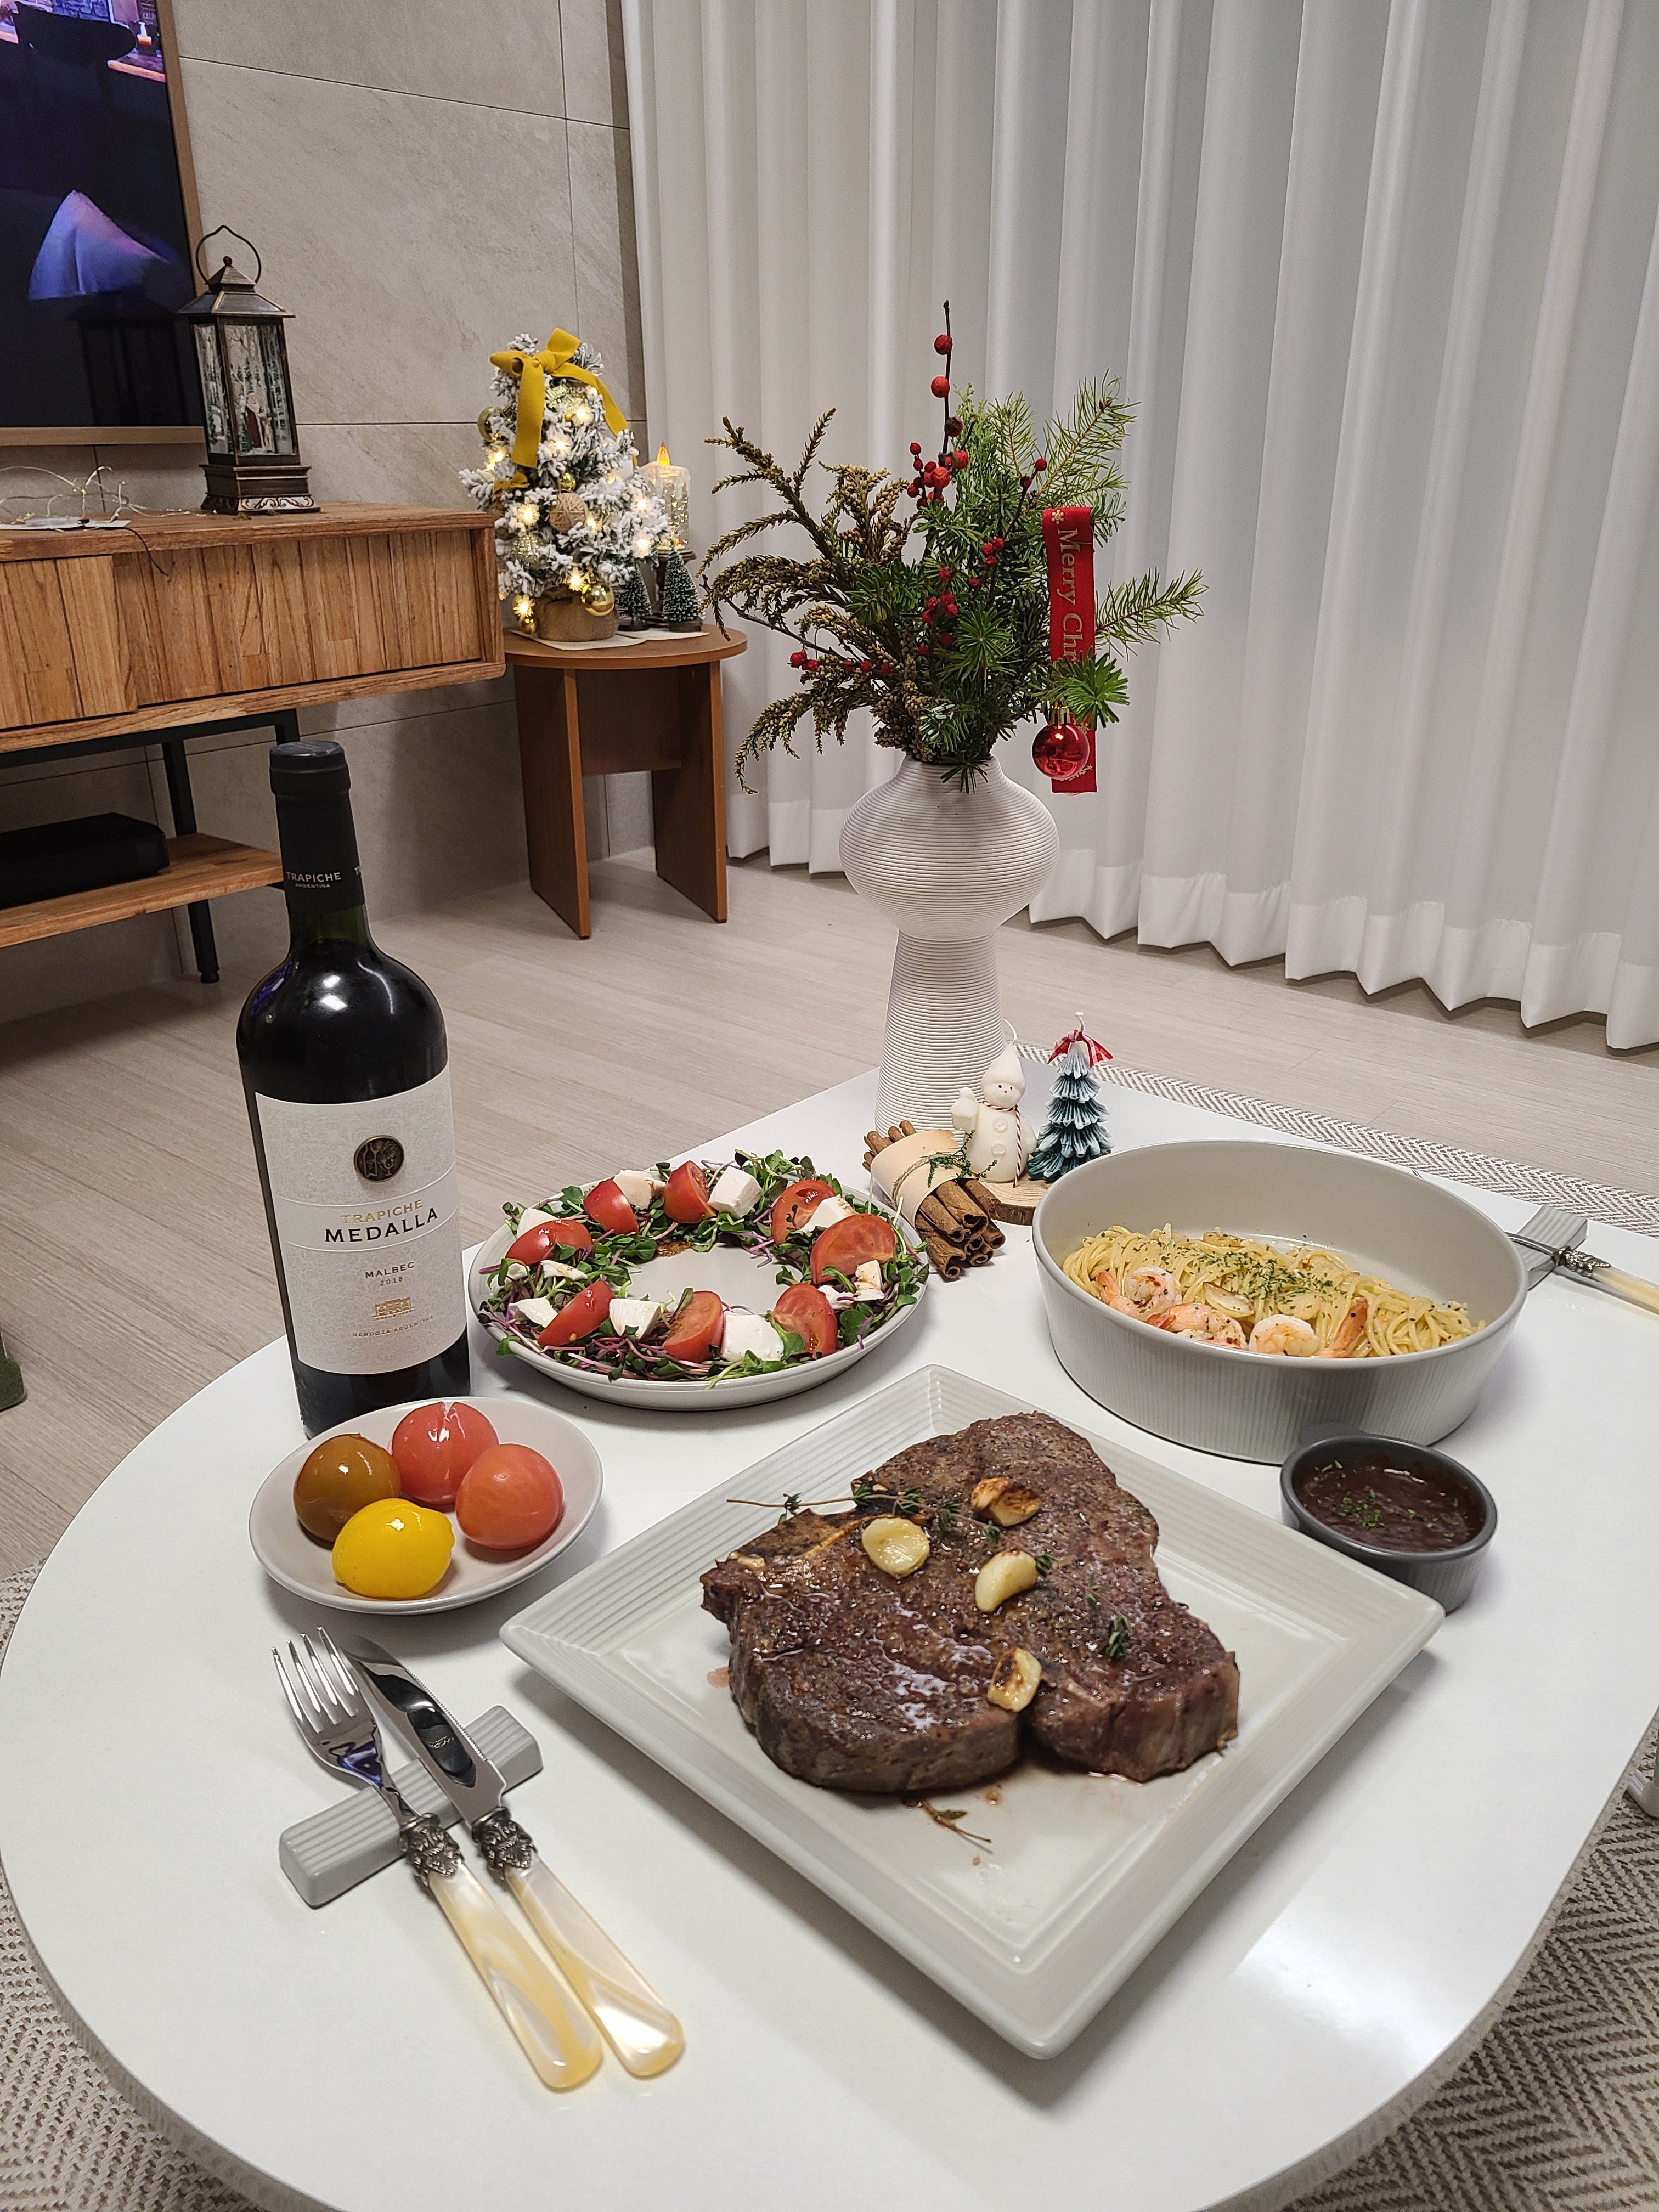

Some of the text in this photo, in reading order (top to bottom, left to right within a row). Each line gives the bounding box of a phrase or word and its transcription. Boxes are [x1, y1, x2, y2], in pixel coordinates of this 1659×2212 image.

[1057, 528, 1083, 663] Merry Chr
[286, 871, 342, 883] TRAPICHE
[340, 1199, 423, 1224] TRAPICHE
[325, 1207, 438, 1243] MEDALLA
[365, 1261, 415, 1279] MALBEC
[380, 1276, 404, 1286] 2018
